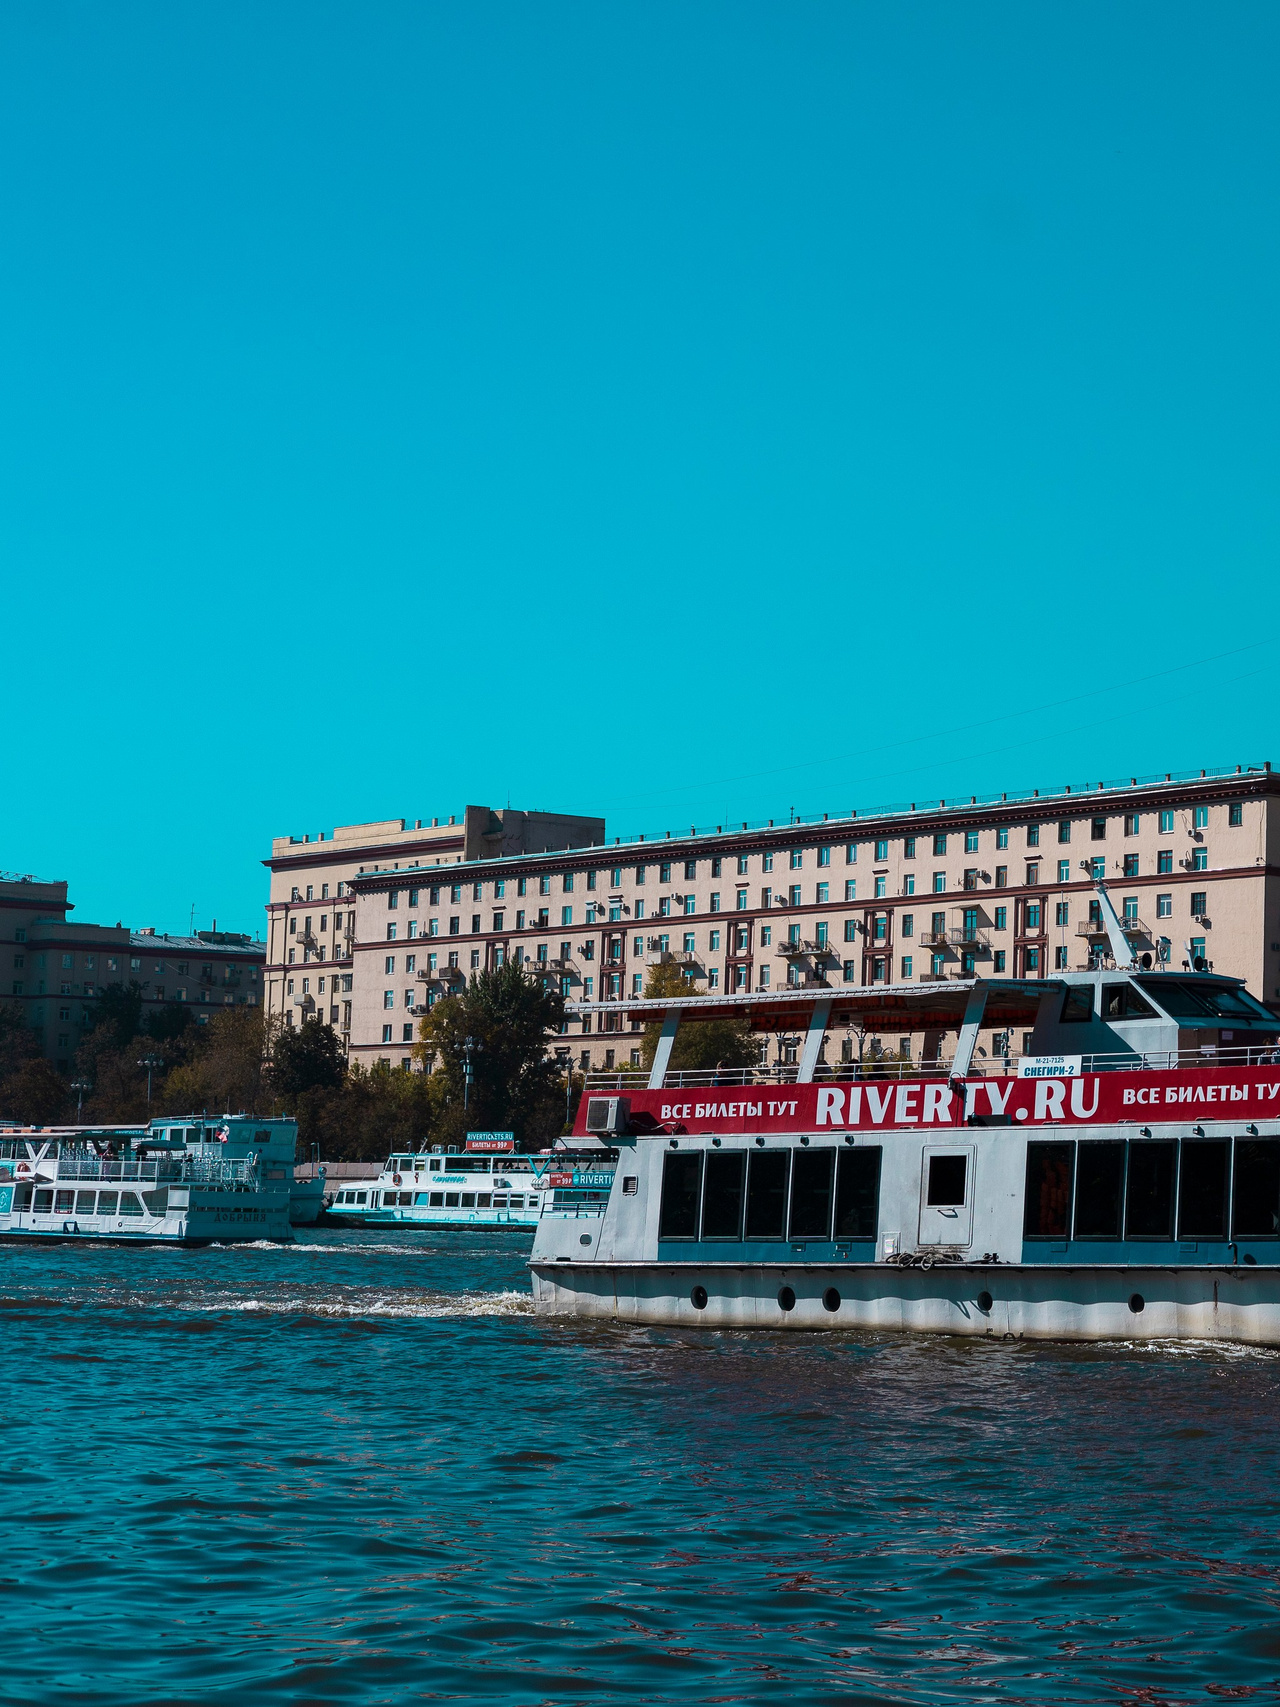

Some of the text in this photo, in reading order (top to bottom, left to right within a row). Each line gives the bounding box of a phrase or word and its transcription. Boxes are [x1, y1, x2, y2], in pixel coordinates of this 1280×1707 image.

[1024, 1065, 1074, 1077] СНЕГИРИ-2
[816, 1078, 1100, 1125] RIVERTY.RU
[1123, 1087, 1160, 1105] ВСЕ
[1165, 1083, 1249, 1103] БИЛЕТЫ
[661, 1100, 798, 1119] ВСЕ БИЛЕТЫ ТУТ
[214, 1213, 266, 1222] ДОБРЫНЯ
